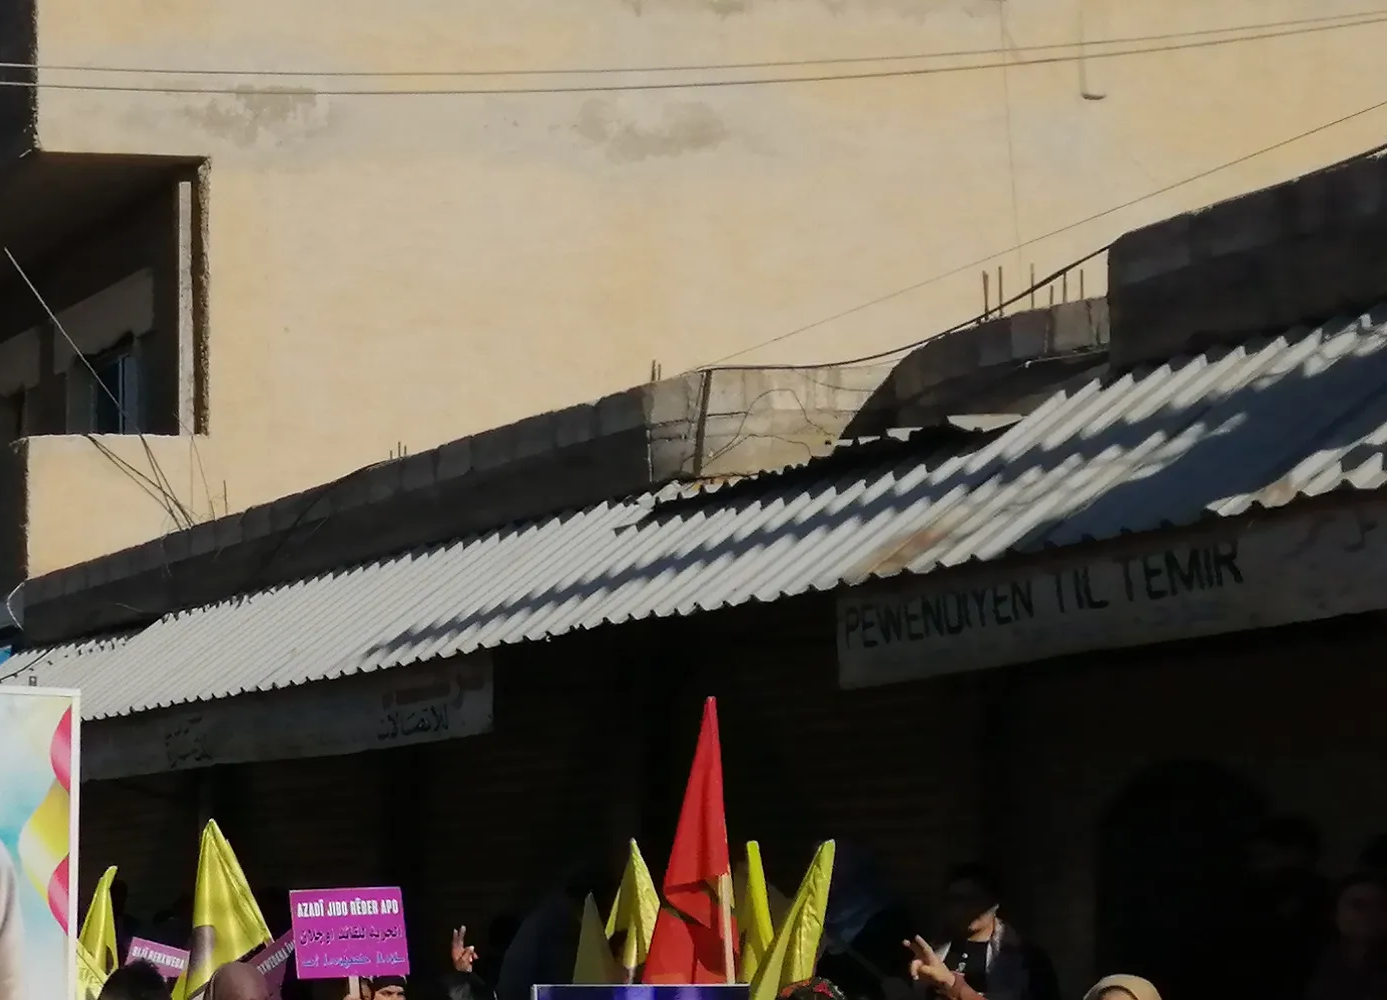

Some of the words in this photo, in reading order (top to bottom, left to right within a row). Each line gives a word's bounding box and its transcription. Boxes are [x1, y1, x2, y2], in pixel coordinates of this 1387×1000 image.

[1054, 565, 1110, 614] TIL
[1121, 539, 1244, 603] TEMIR
[297, 899, 324, 918] AZADÎ
[327, 901, 348, 917] JIBO
[350, 897, 378, 916] RÊBER
[380, 899, 399, 914] APO
